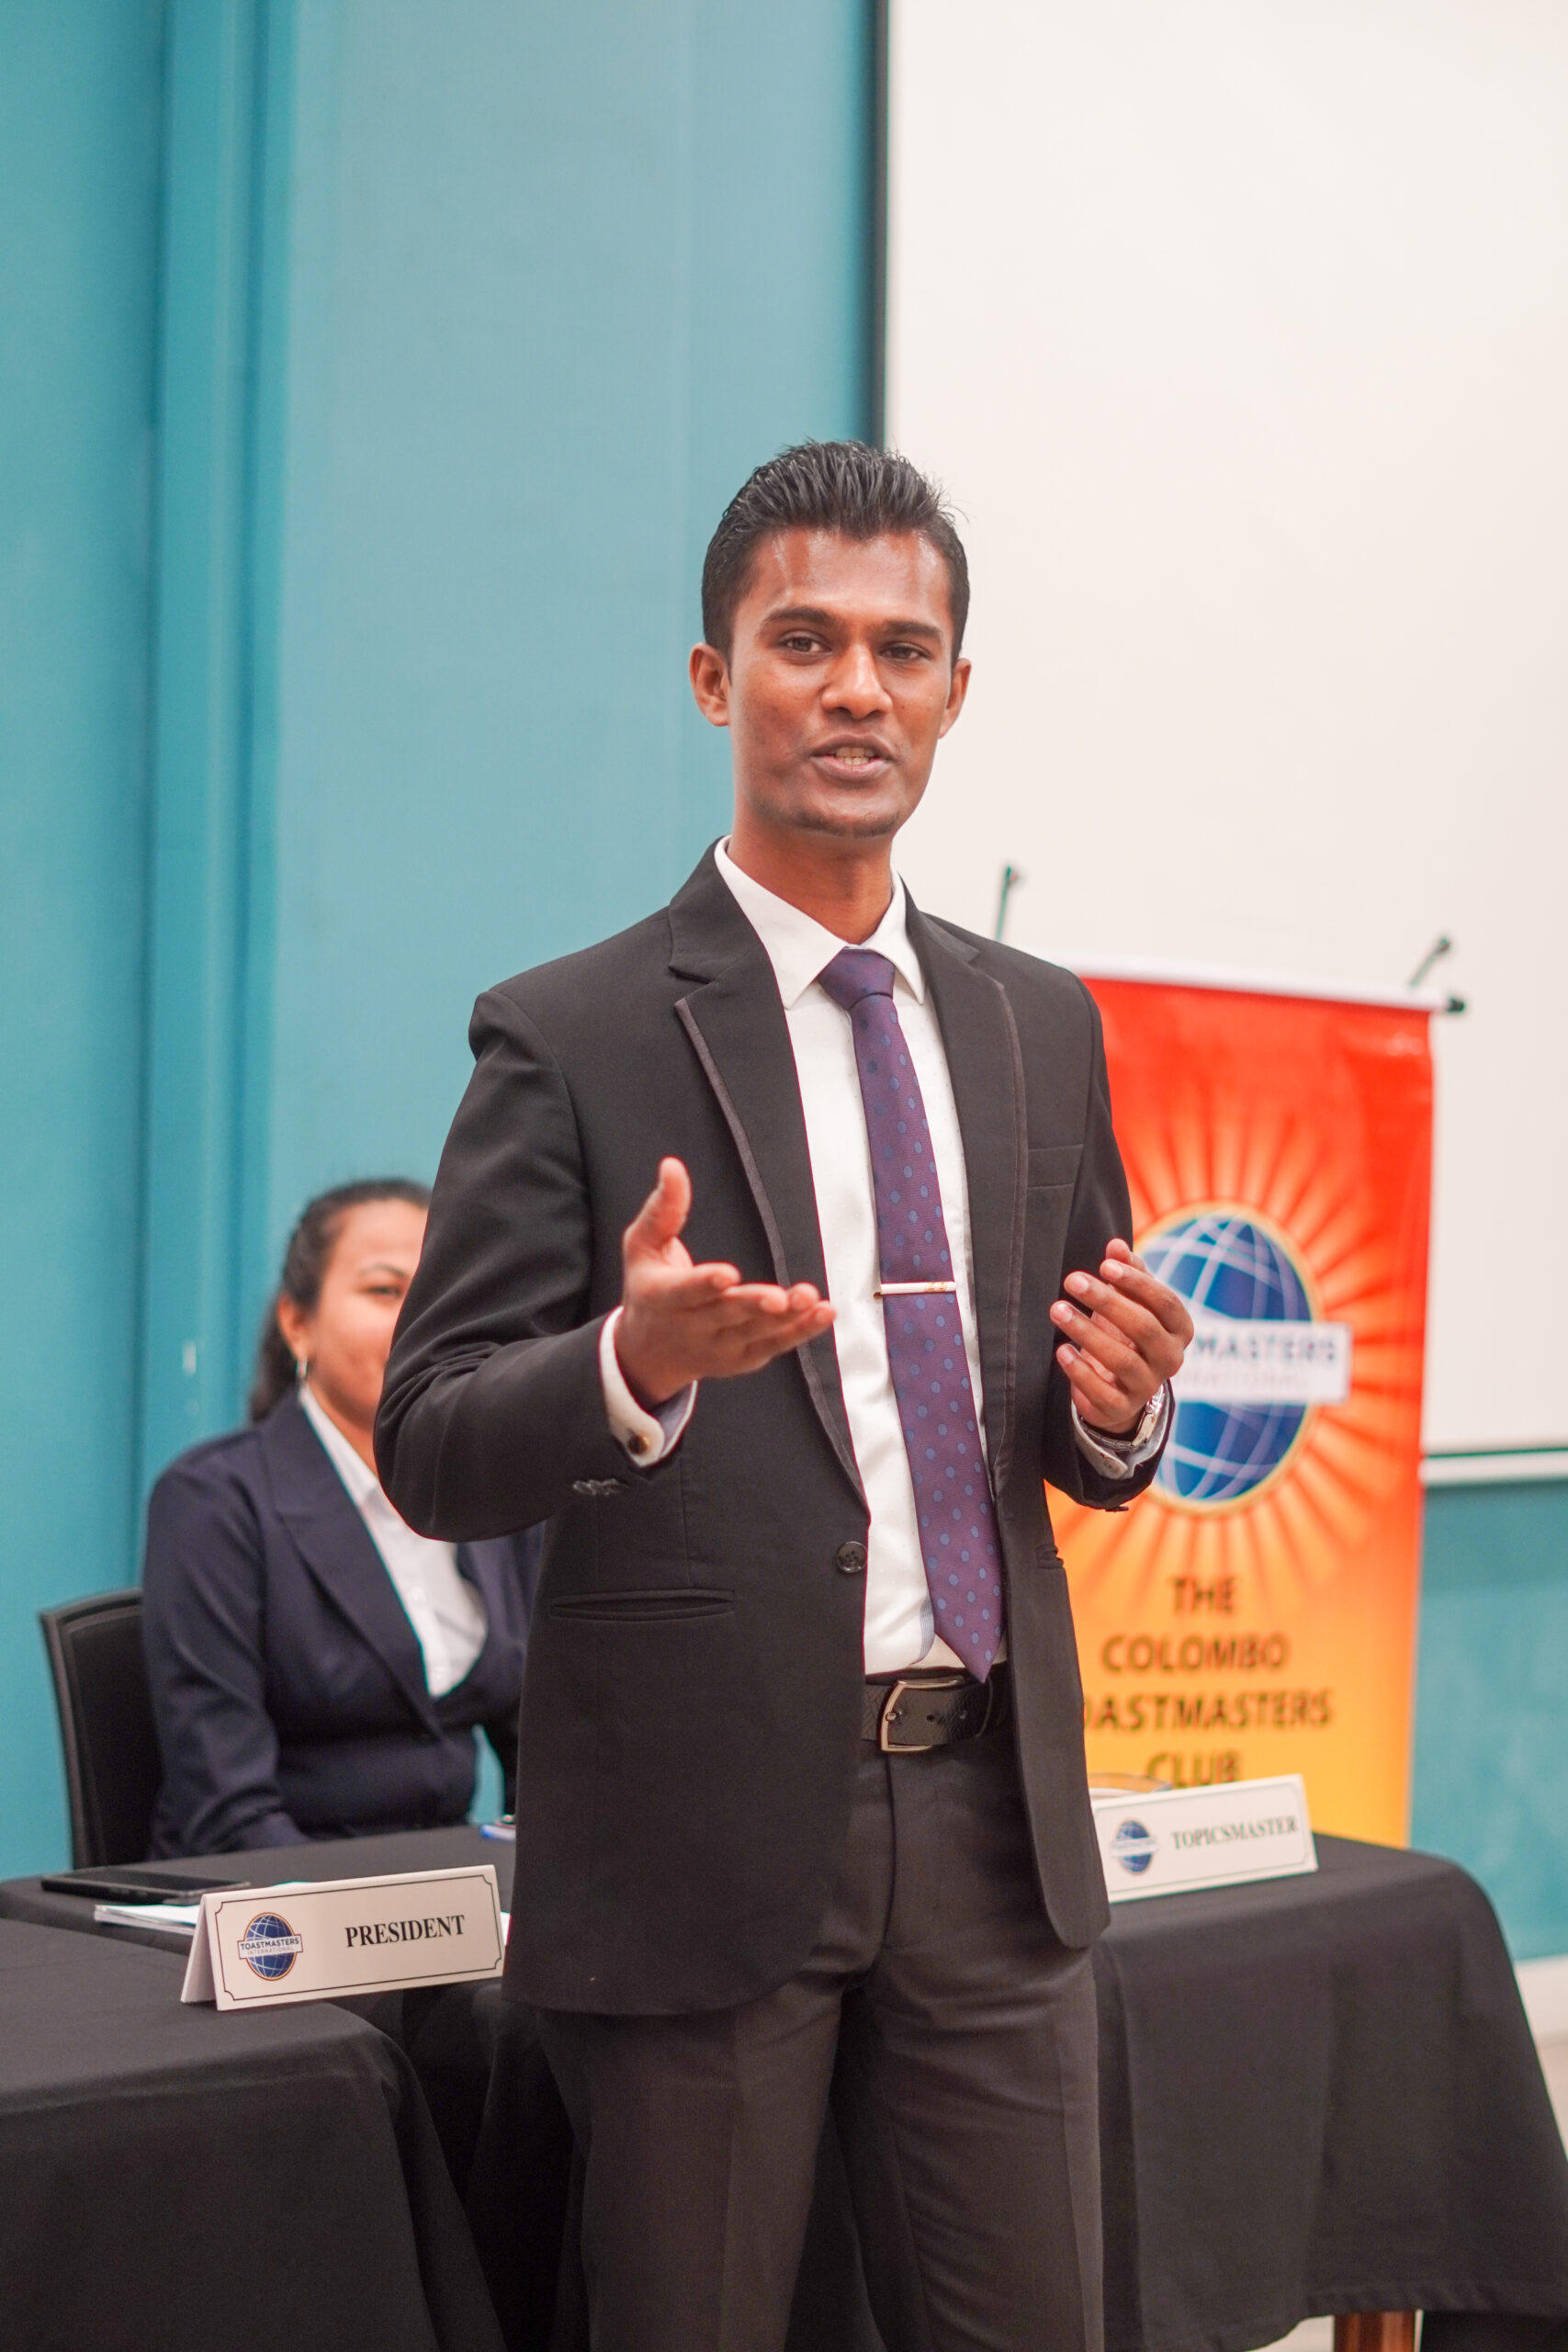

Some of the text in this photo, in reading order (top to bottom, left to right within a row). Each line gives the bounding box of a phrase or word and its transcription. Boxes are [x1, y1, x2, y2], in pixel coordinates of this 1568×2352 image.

[1194, 1334, 1337, 1362] MASTERS
[1171, 1577, 1235, 1612] THE
[1101, 1633, 1288, 1673] COLOMBO
[1084, 1690, 1333, 1731] ASTMASTERS
[1147, 1751, 1237, 1789] CLUB
[1171, 1815, 1299, 1850] TOPICSMASTER
[240, 1937, 299, 1951] TOASTMASTERS
[344, 1914, 465, 1948] PRESIDENT
